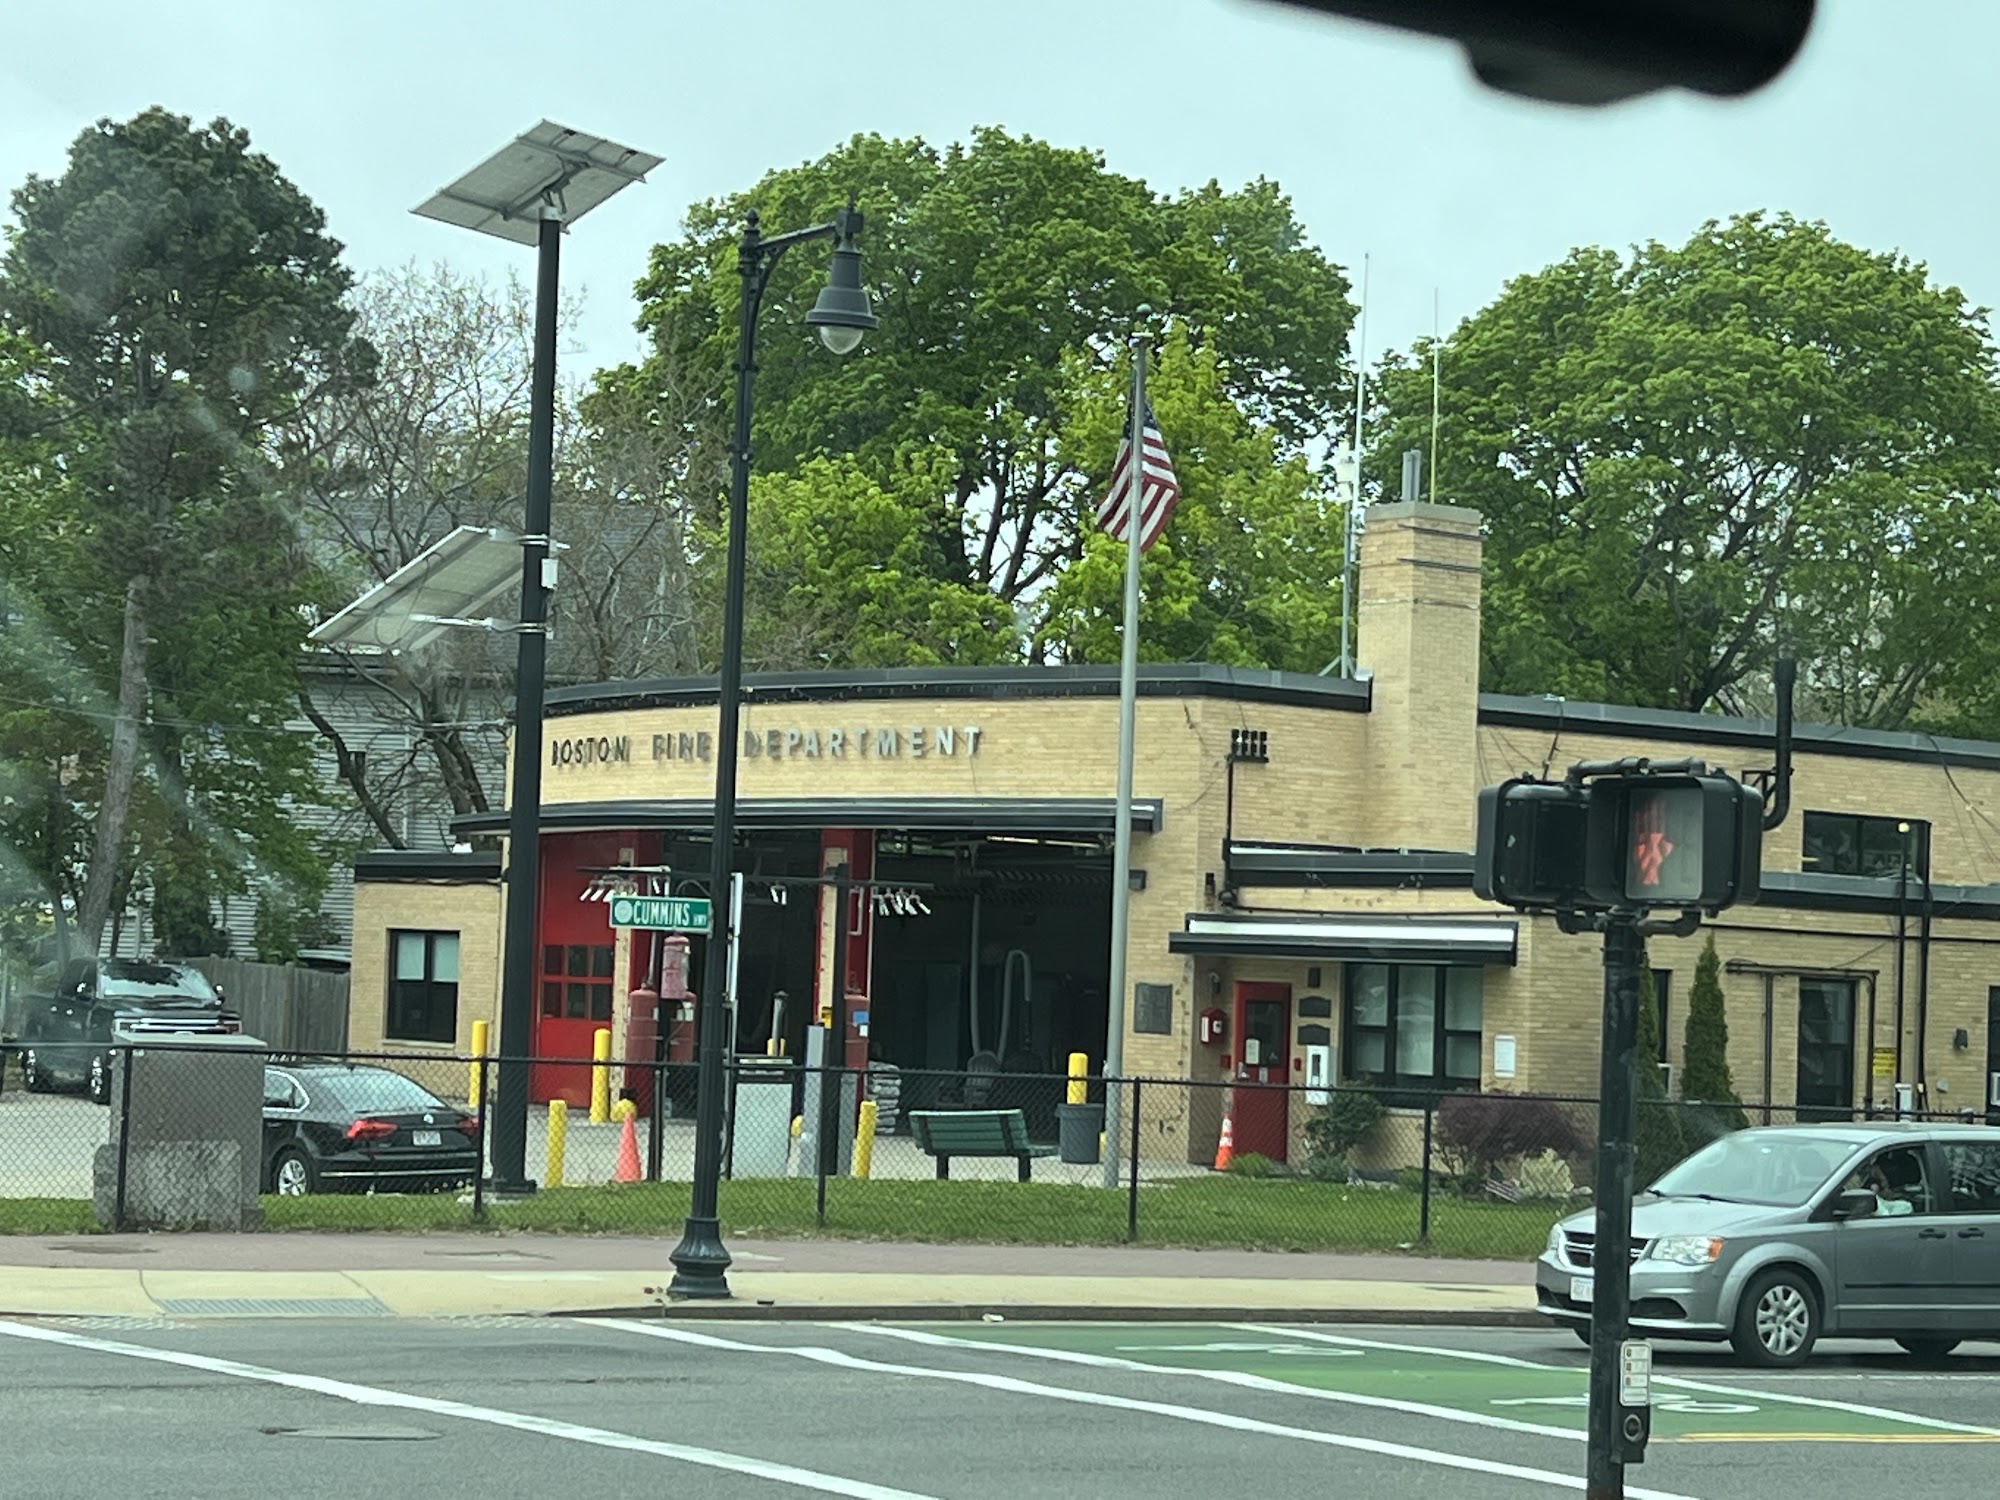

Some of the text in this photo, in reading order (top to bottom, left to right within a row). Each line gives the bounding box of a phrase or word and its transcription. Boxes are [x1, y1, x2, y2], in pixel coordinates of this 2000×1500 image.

[551, 725, 982, 766] BOSTON FIRE DEPARTMENT
[633, 900, 690, 927] CUMMINS
